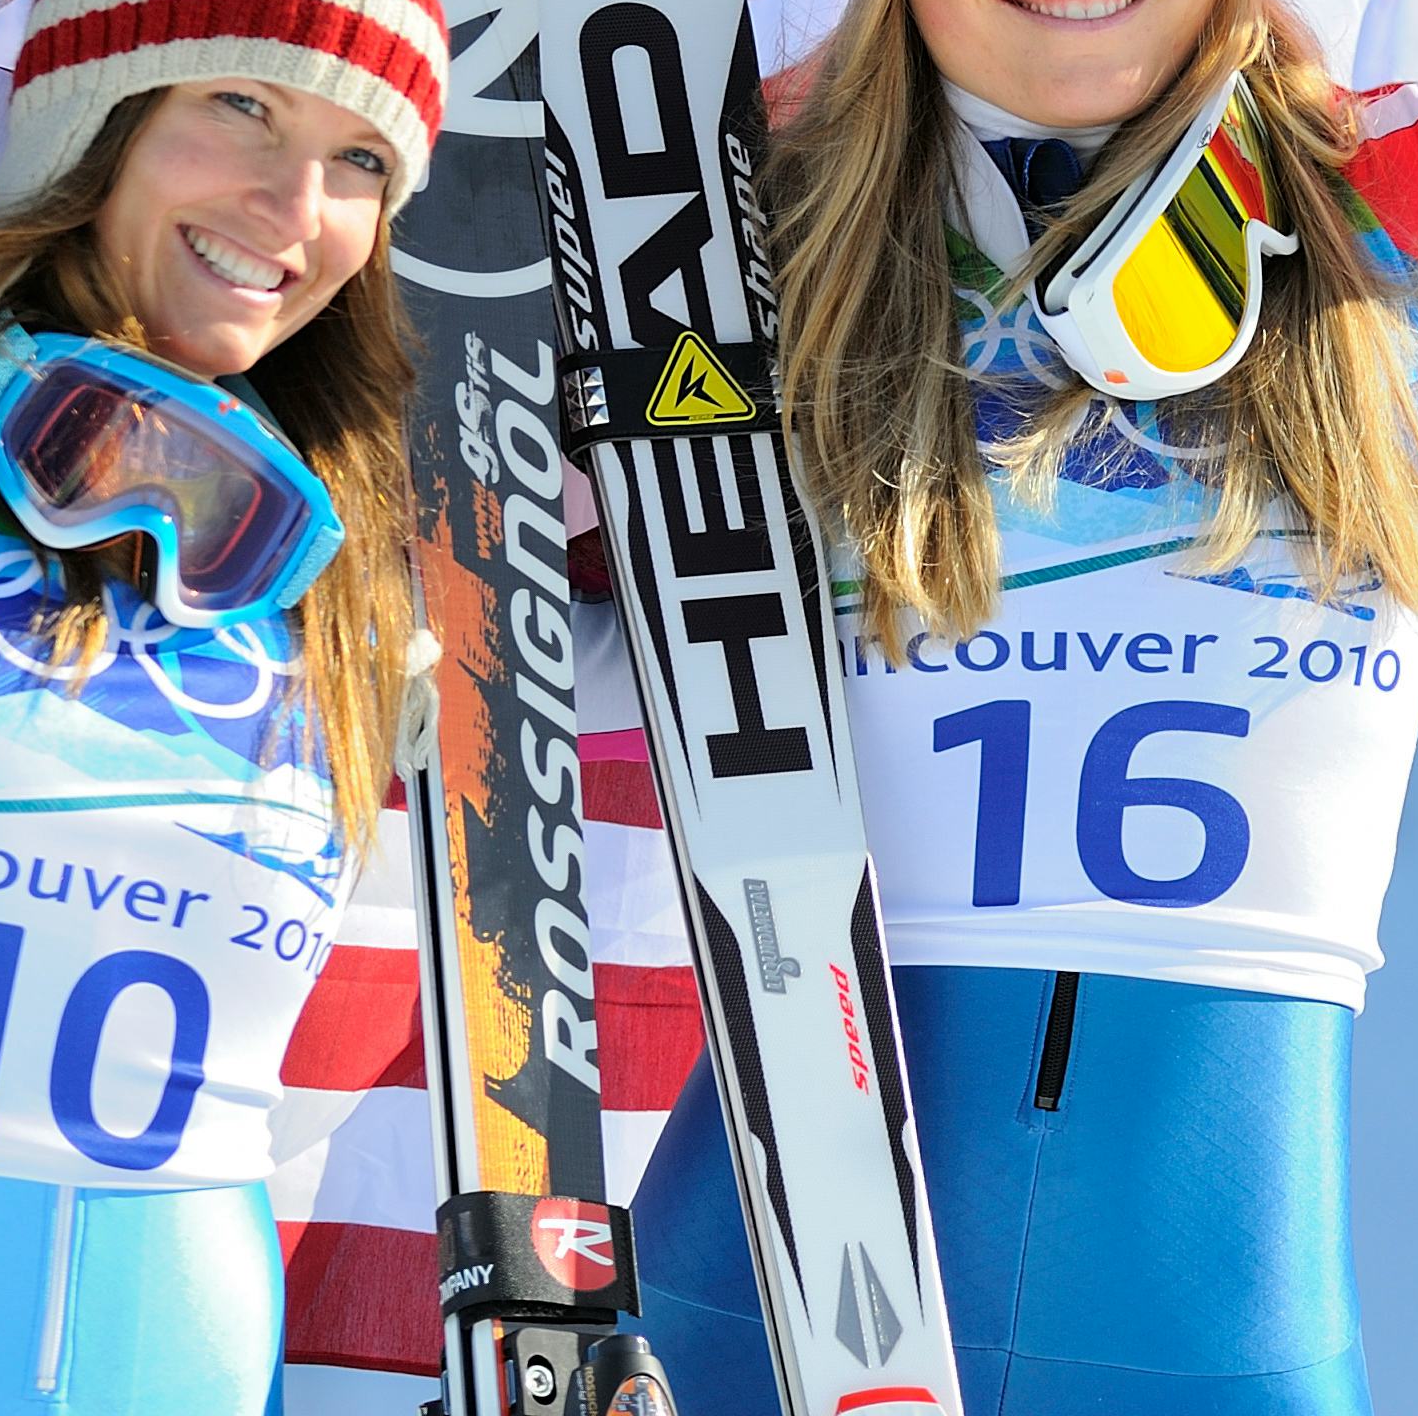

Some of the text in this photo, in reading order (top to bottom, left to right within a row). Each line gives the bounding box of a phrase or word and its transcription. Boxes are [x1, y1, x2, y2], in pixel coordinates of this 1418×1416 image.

[546, 148, 600, 352] super
[728, 130, 780, 341] shape
[580, 2, 814, 780] HEAD
[490, 337, 601, 1095] ROSSIGNOL
[839, 630, 1402, 692] ncouver 2010
[933, 697, 1252, 910] 16
[828, 961, 870, 1097] speed
